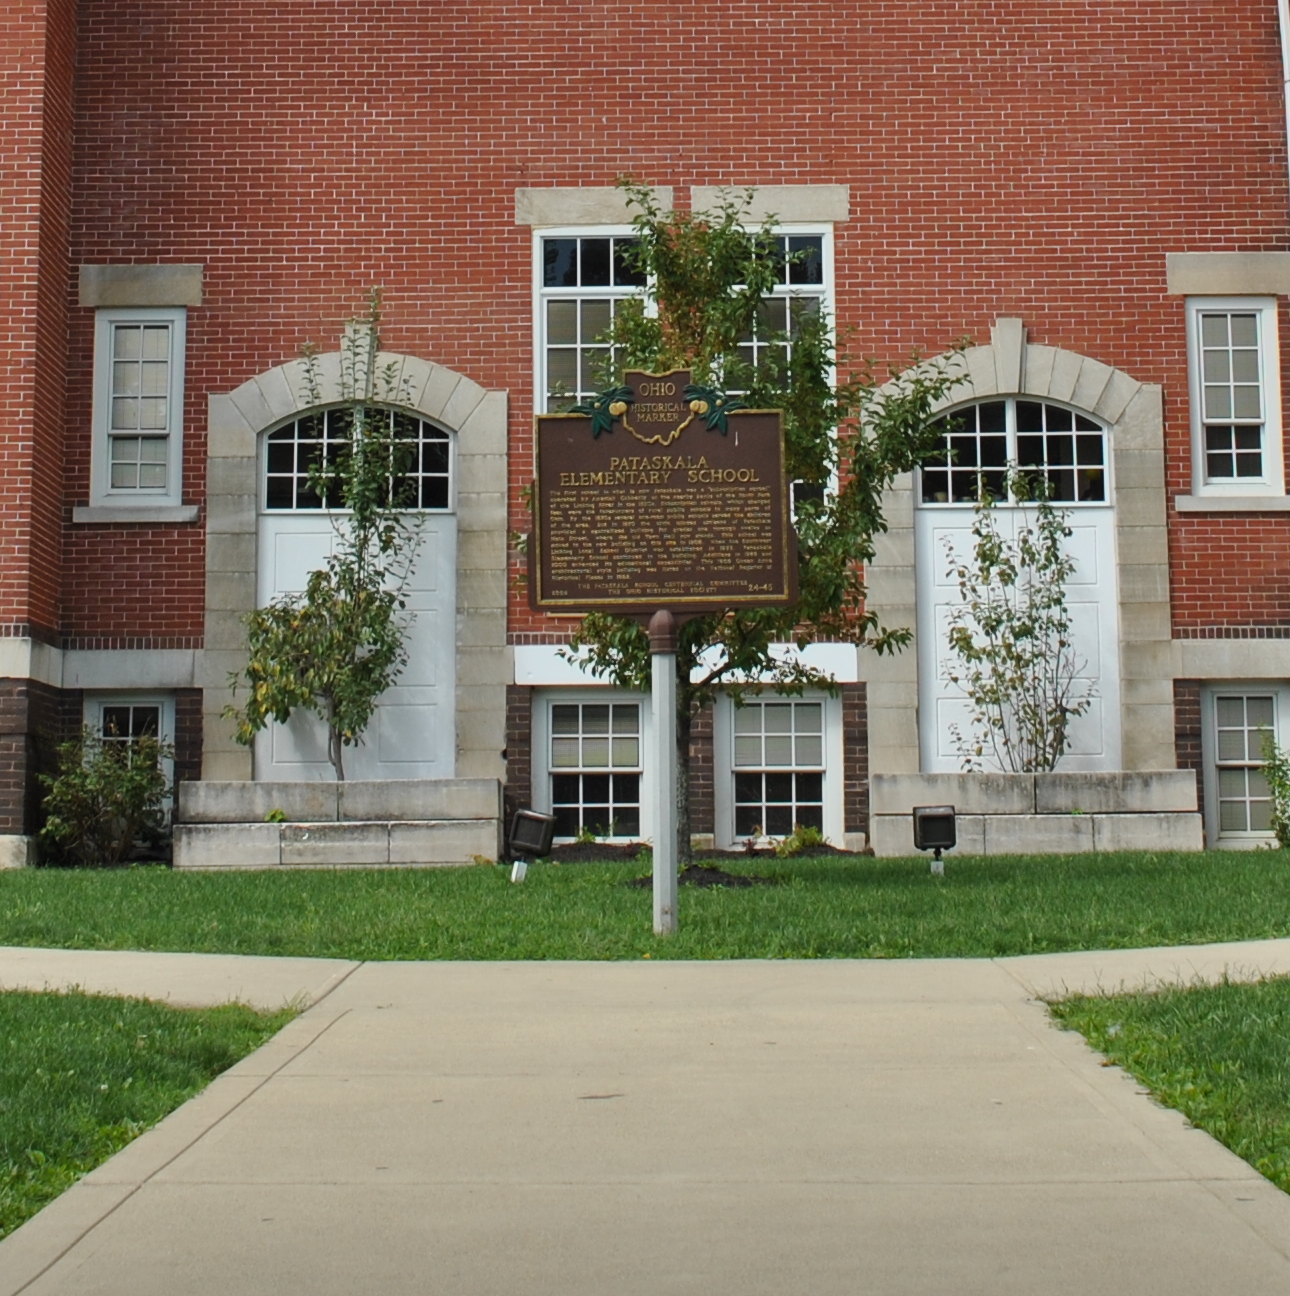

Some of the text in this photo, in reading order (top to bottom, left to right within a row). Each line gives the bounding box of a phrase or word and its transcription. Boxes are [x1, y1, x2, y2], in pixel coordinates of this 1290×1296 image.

[639, 382, 675, 397] OHIO
[631, 402, 686, 413] HISTORICAL
[637, 413, 679, 422] MARKER
[610, 456, 709, 470] PATASKALA
[560, 468, 759, 486] ELEMENTARY SCHOOL
